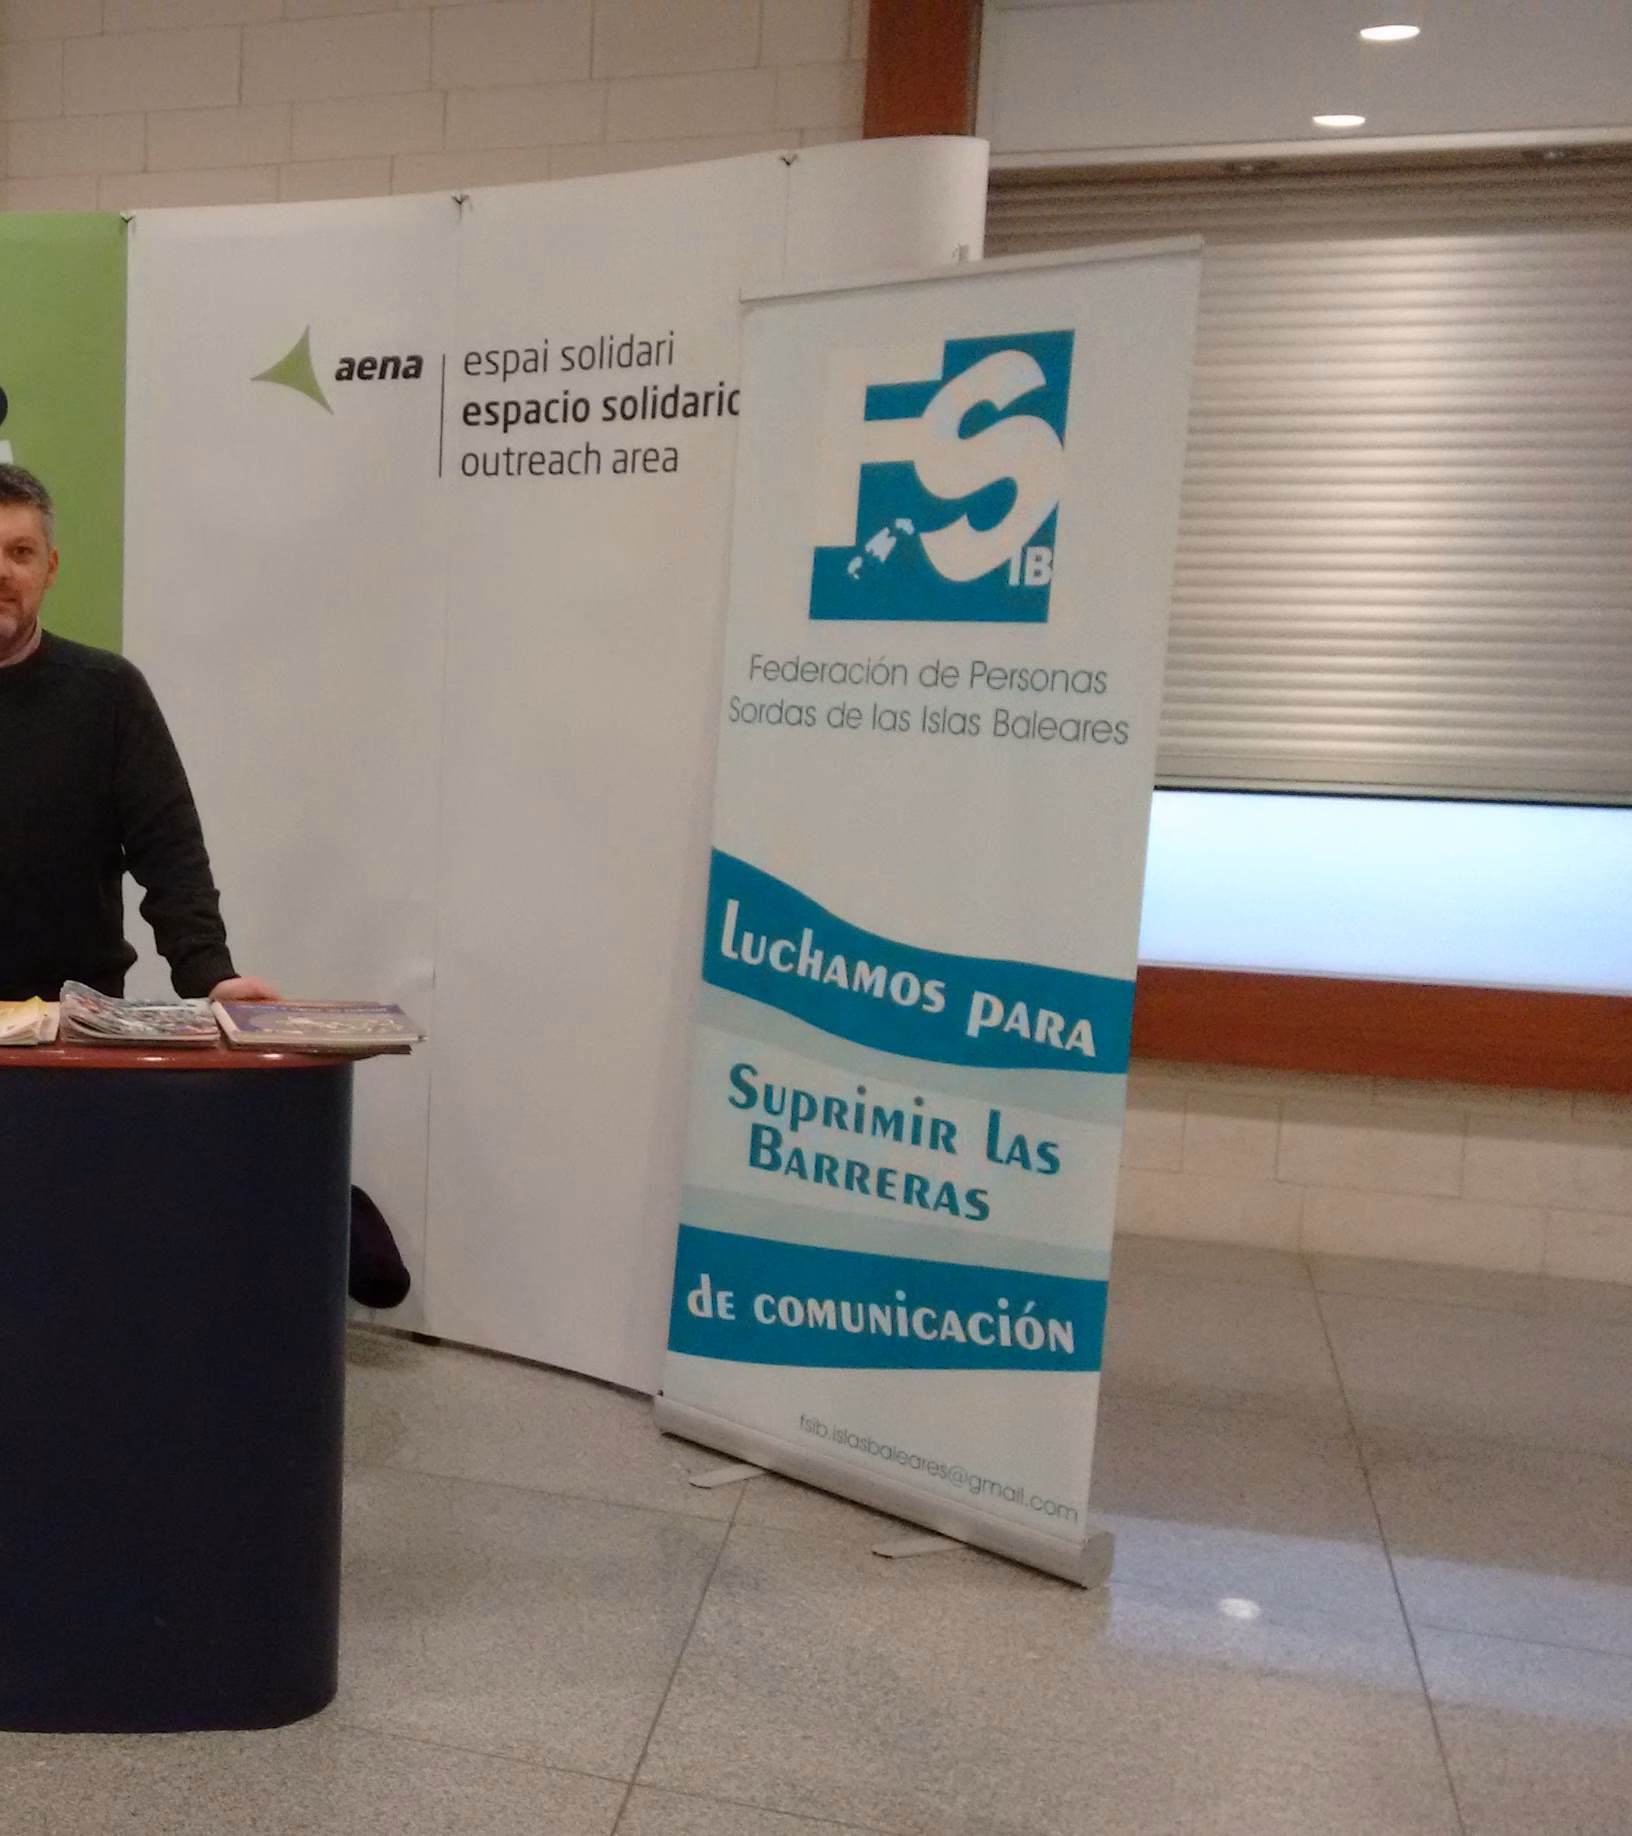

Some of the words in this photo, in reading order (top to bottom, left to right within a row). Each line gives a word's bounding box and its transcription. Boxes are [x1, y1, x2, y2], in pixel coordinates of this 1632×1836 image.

[335, 354, 424, 381] aena
[463, 339, 550, 382] espai
[561, 331, 675, 372] solidari
[462, 390, 591, 432] espacio
[461, 442, 602, 478] outreach
[612, 445, 679, 475] area
[749, 654, 908, 686] Federación
[919, 659, 960, 688] de
[969, 660, 1108, 695] Personas
[728, 696, 817, 728] Sordas
[826, 700, 863, 730] de
[872, 702, 911, 733] las
[921, 706, 981, 737] Islas
[992, 709, 1130, 746] Baleares
[799, 1413, 1080, 1523] fsib.islasbaleares@gmail.com
